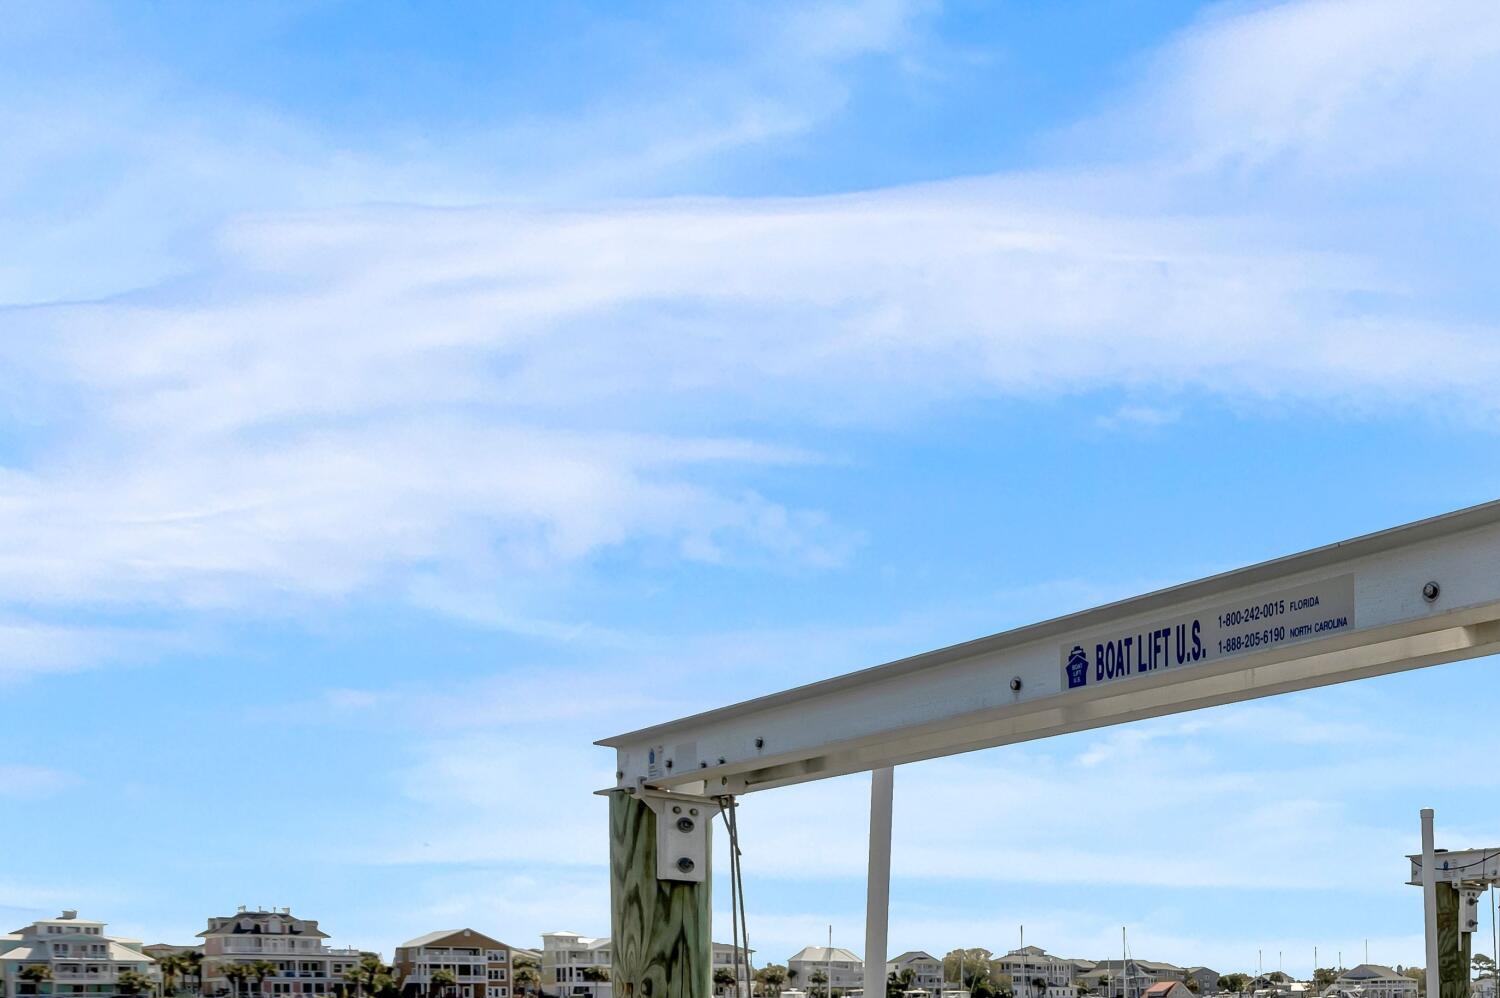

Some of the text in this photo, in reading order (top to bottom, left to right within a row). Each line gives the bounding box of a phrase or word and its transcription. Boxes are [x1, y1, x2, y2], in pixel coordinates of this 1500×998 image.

[1218, 596, 1320, 629] 1-800-242-0015 FLORIDA
[1096, 620, 1206, 682] BOAT LIFT U.S.
[1218, 616, 1348, 654] 1-888-205-6190 NORTH CAROLINA
